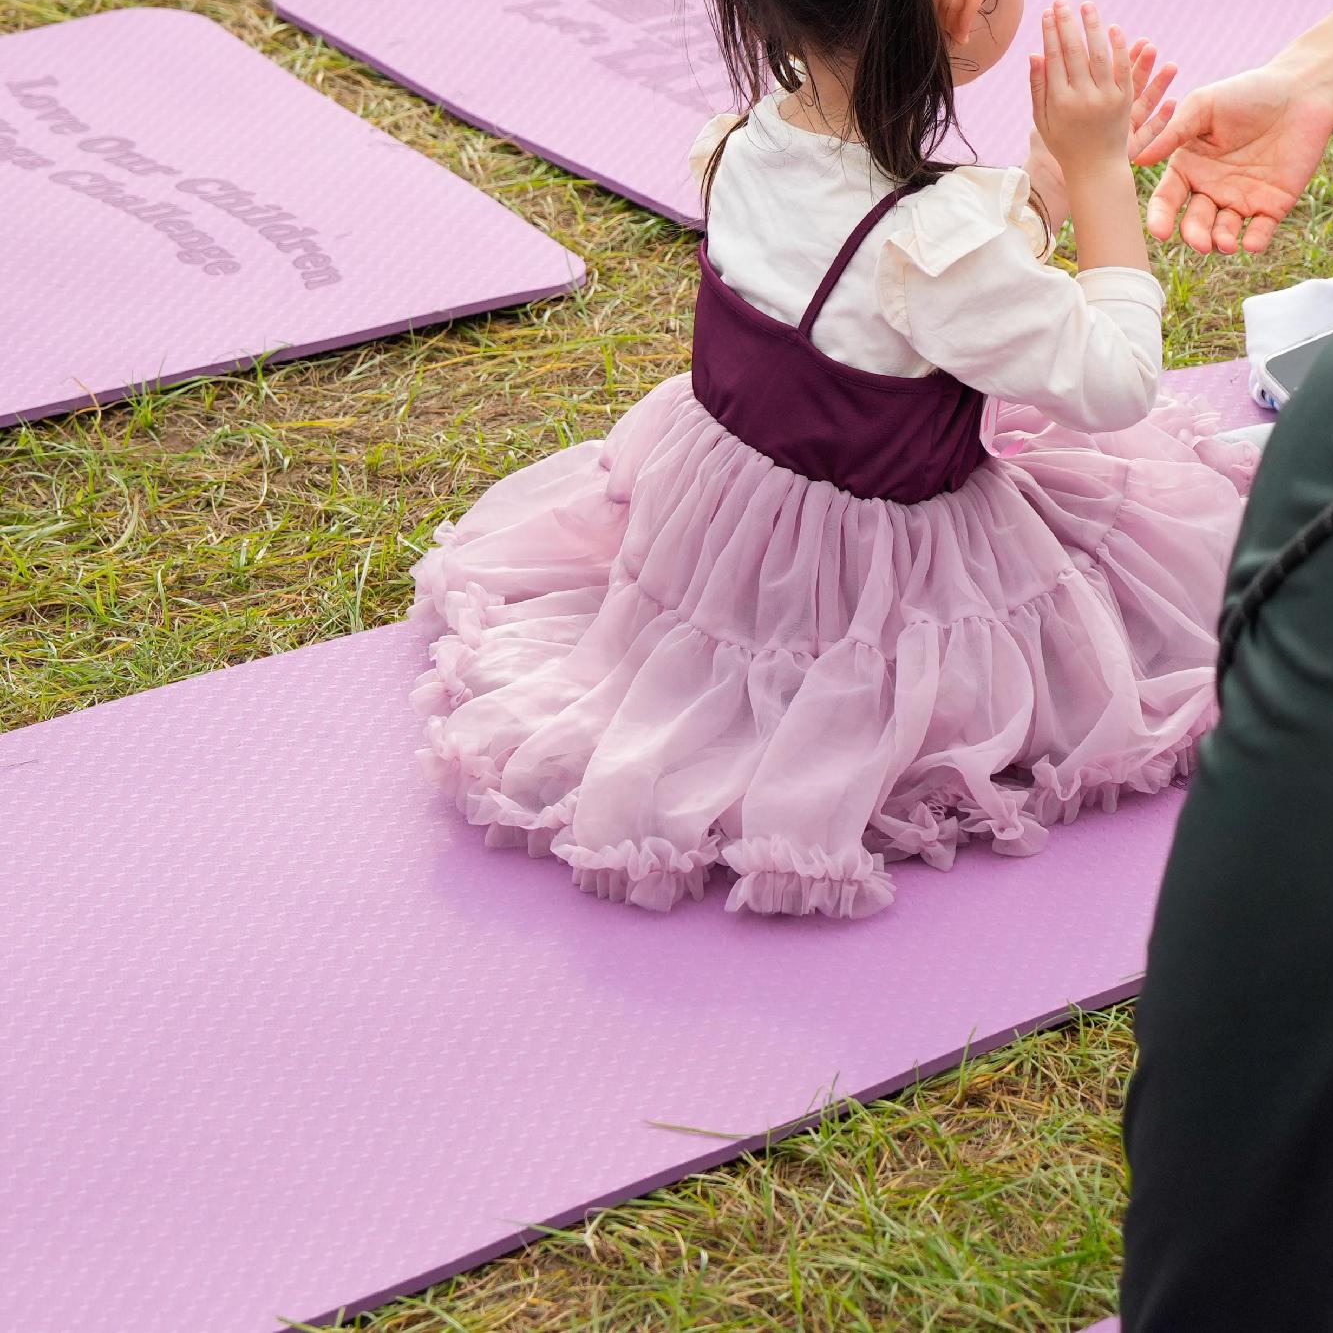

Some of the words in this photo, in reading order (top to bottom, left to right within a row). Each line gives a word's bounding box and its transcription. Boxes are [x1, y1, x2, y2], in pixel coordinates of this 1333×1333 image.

[5, 74, 91, 136] Love
[76, 135, 184, 177] Our
[174, 177, 343, 291] Children
[48, 169, 243, 277] Challenge
